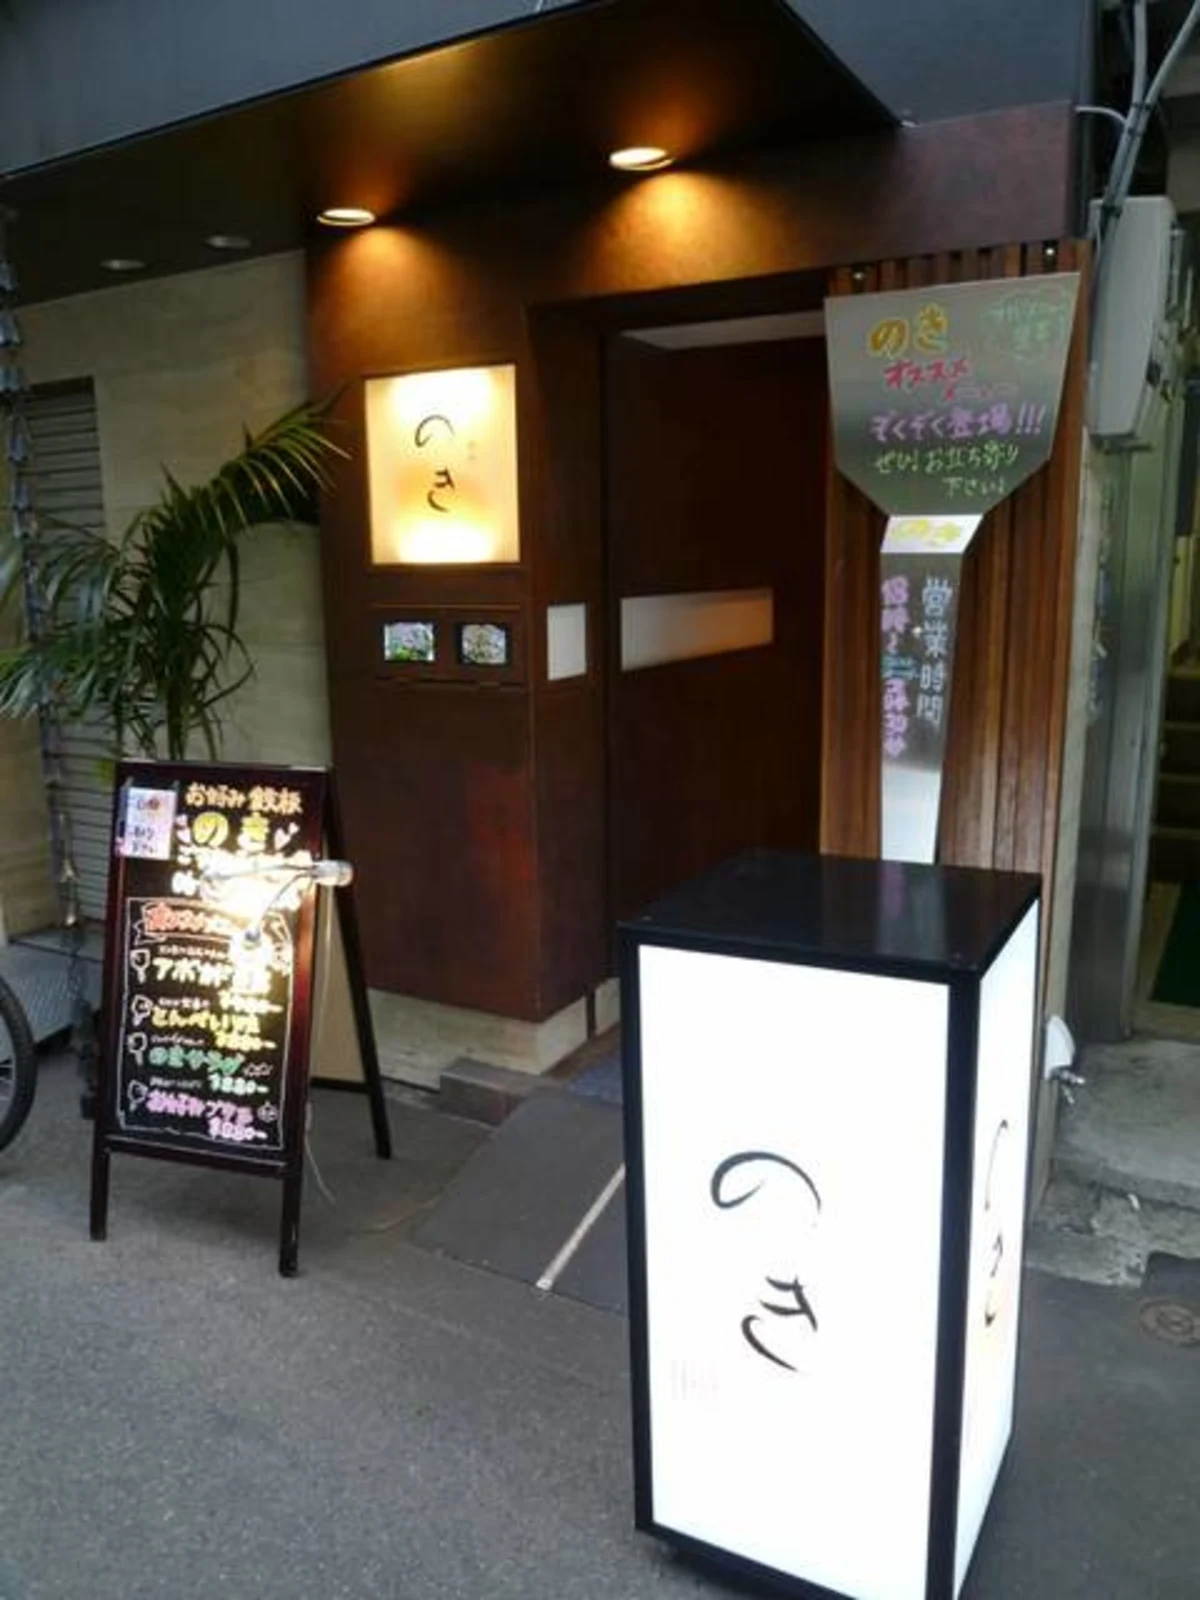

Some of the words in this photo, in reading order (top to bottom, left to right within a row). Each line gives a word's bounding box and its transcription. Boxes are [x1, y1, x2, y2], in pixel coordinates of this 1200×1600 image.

[867, 303, 948, 357] のき
[915, 575, 955, 730] 営業時間
[192, 811, 271, 851] のき
[710, 1150, 822, 1373] のき
